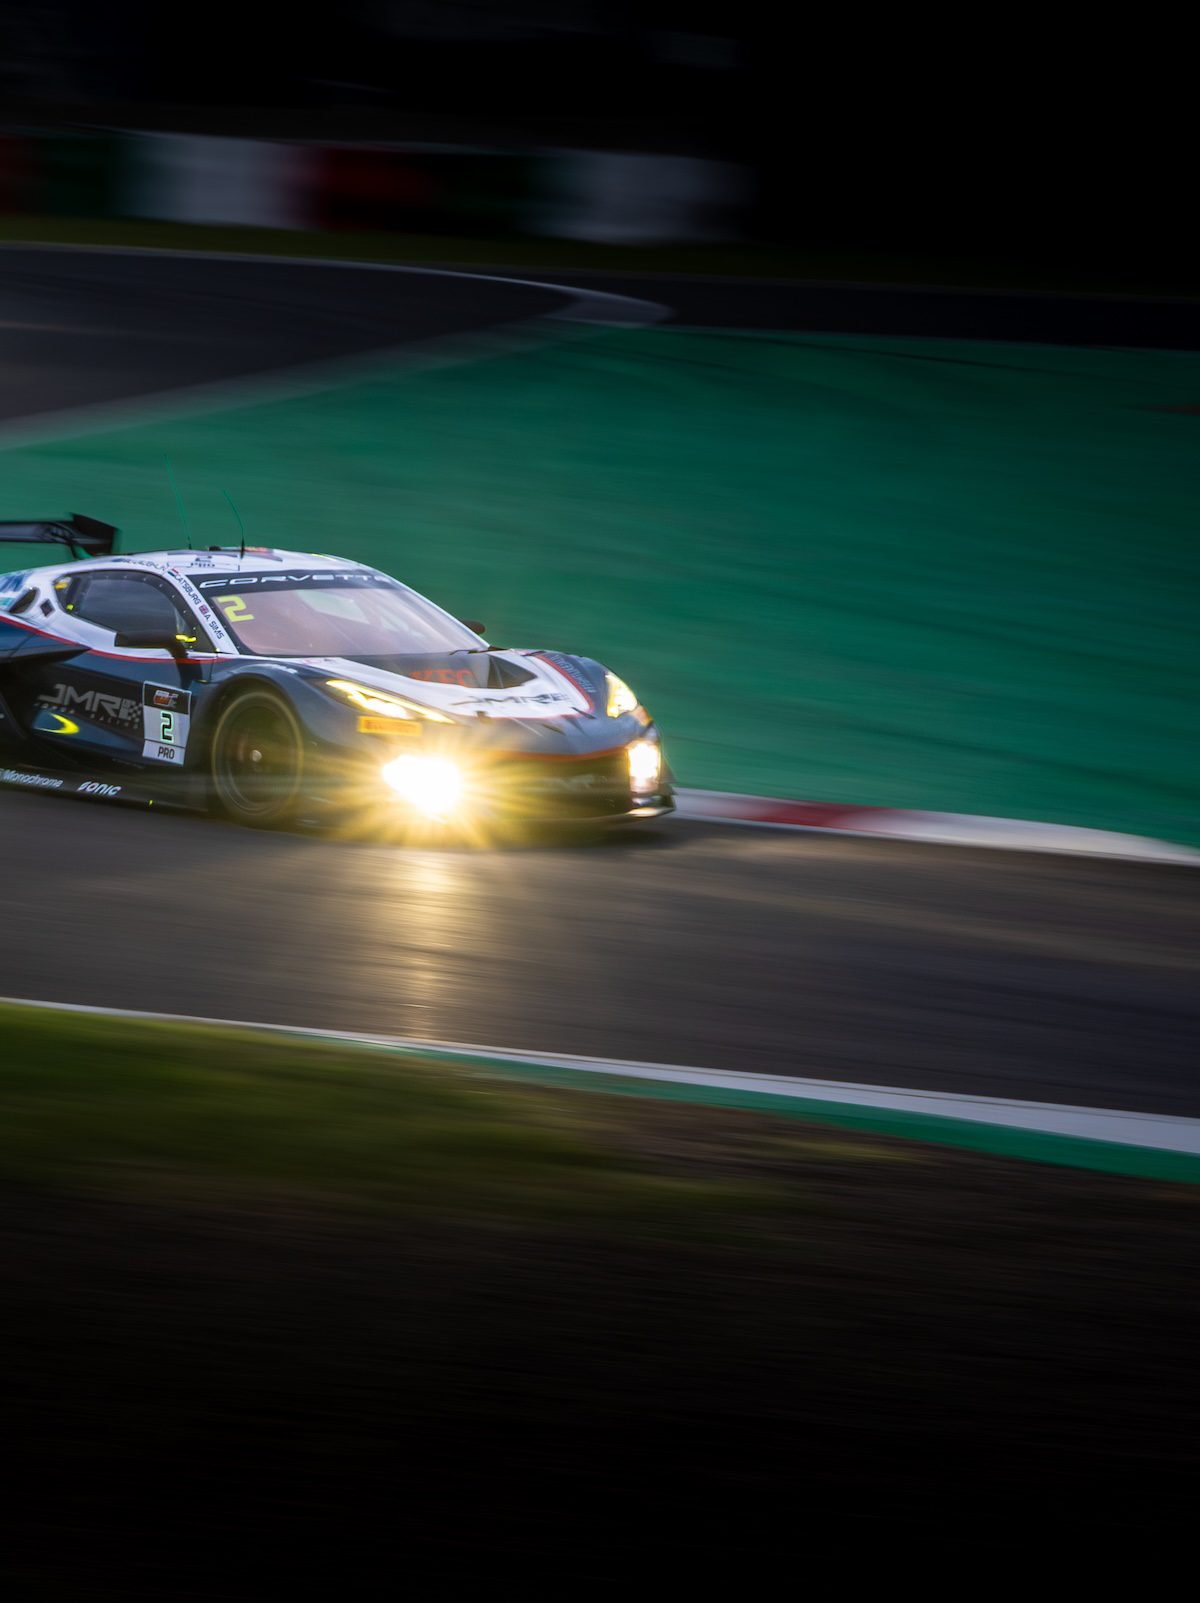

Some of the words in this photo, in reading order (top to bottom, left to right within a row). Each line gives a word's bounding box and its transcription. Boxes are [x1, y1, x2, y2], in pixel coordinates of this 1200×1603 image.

[216, 594, 256, 622] 2
[209, 620, 225, 640] SIMS
[160, 710, 175, 743] 2
[157, 746, 175, 760] PRO
